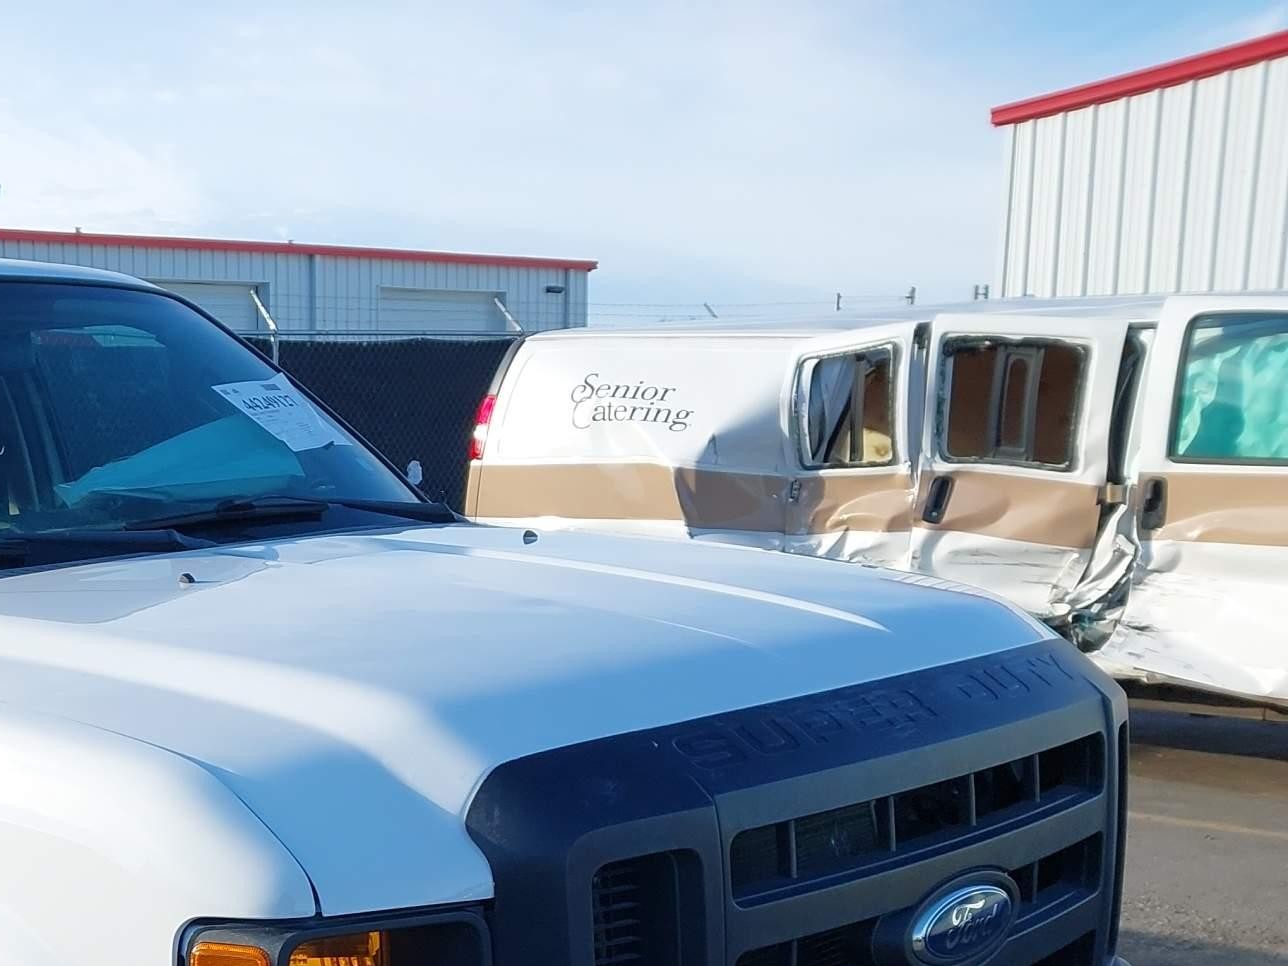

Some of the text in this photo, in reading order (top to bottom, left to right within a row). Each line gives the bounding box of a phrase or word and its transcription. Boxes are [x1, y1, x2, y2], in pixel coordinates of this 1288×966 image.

[242, 395, 297, 411] 44249127
[571, 373, 676, 403] Senior
[572, 397, 694, 432] Catering
[673, 653, 1074, 770] SUPER DUTY
[945, 899, 999, 949] Ford
